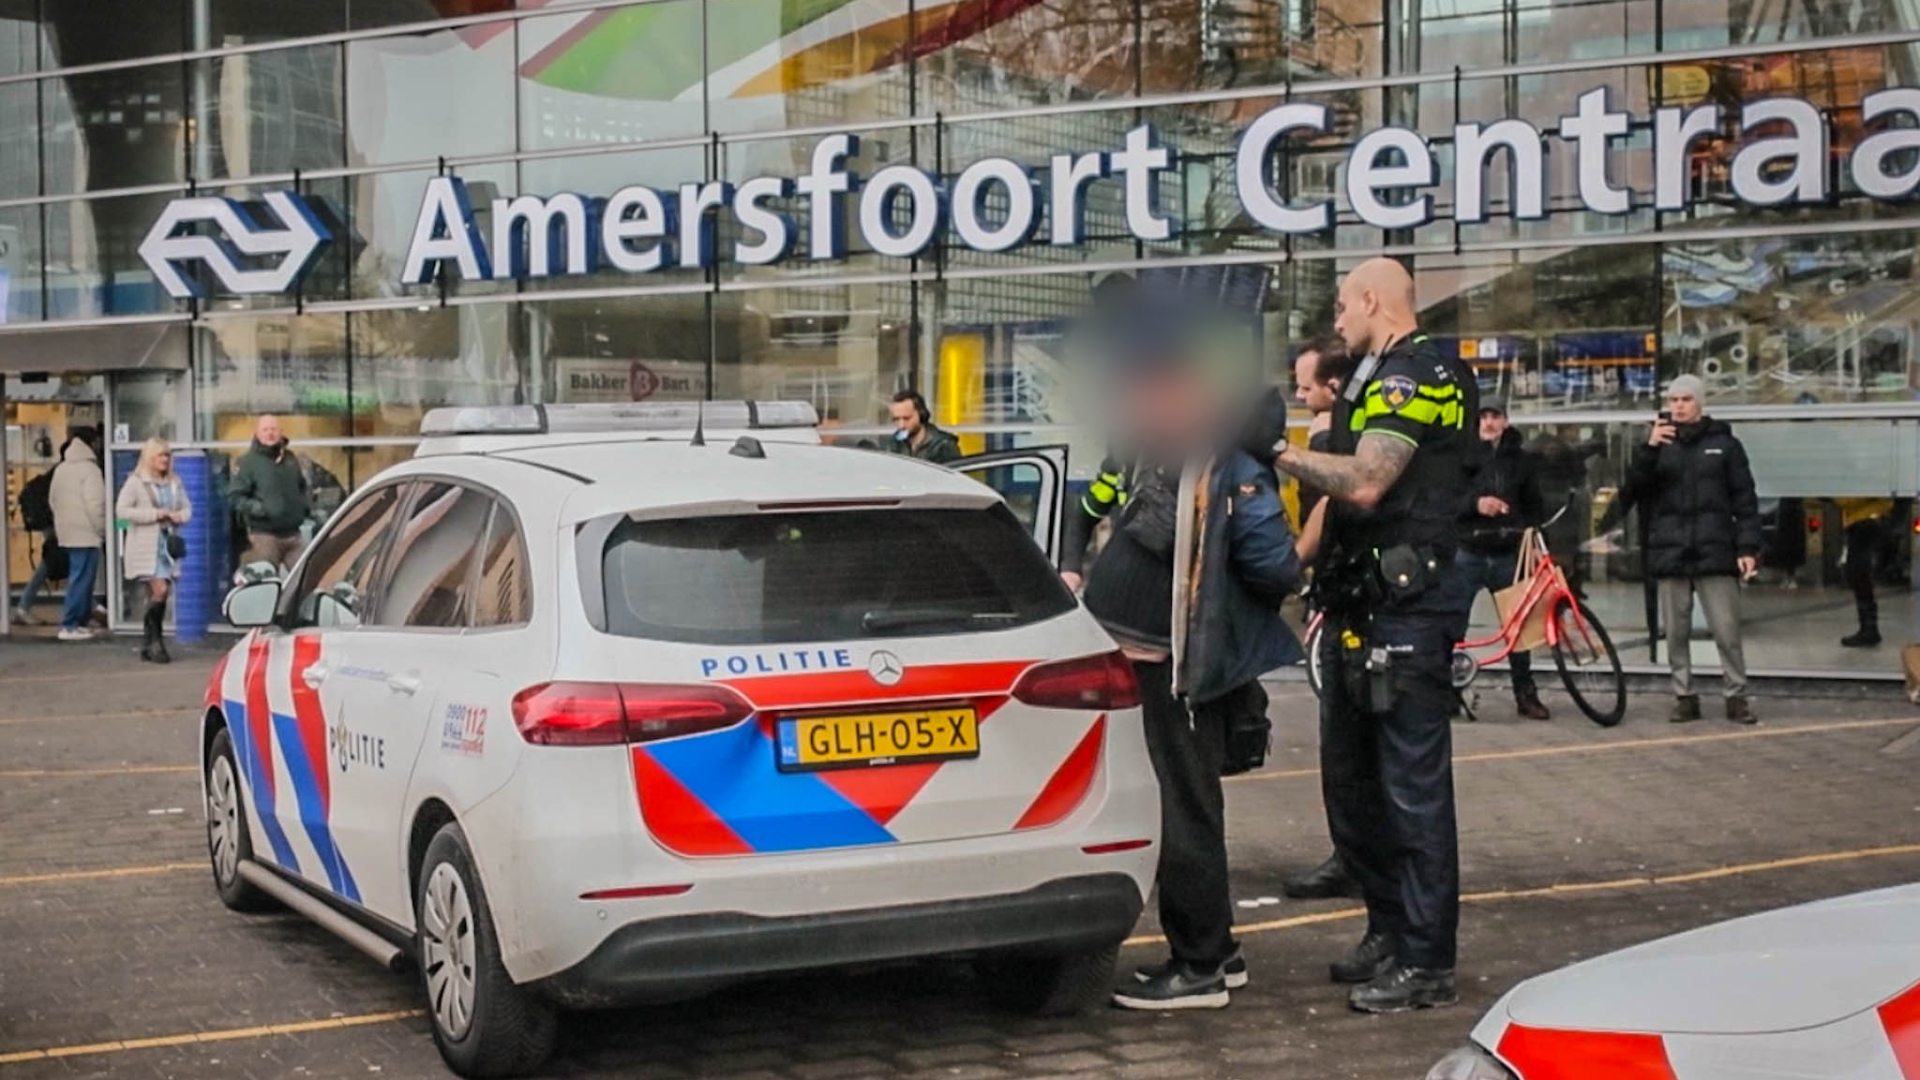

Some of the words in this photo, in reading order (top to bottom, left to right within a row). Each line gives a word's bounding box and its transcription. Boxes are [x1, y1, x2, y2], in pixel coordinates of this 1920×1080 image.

[401, 124, 1170, 284] Amersfoort
[570, 373, 627, 390] Bakker
[661, 376, 690, 391] Bart
[701, 649, 853, 677] POLITIE
[465, 706, 487, 736] 112
[809, 716, 967, 755] GLH-05-X
